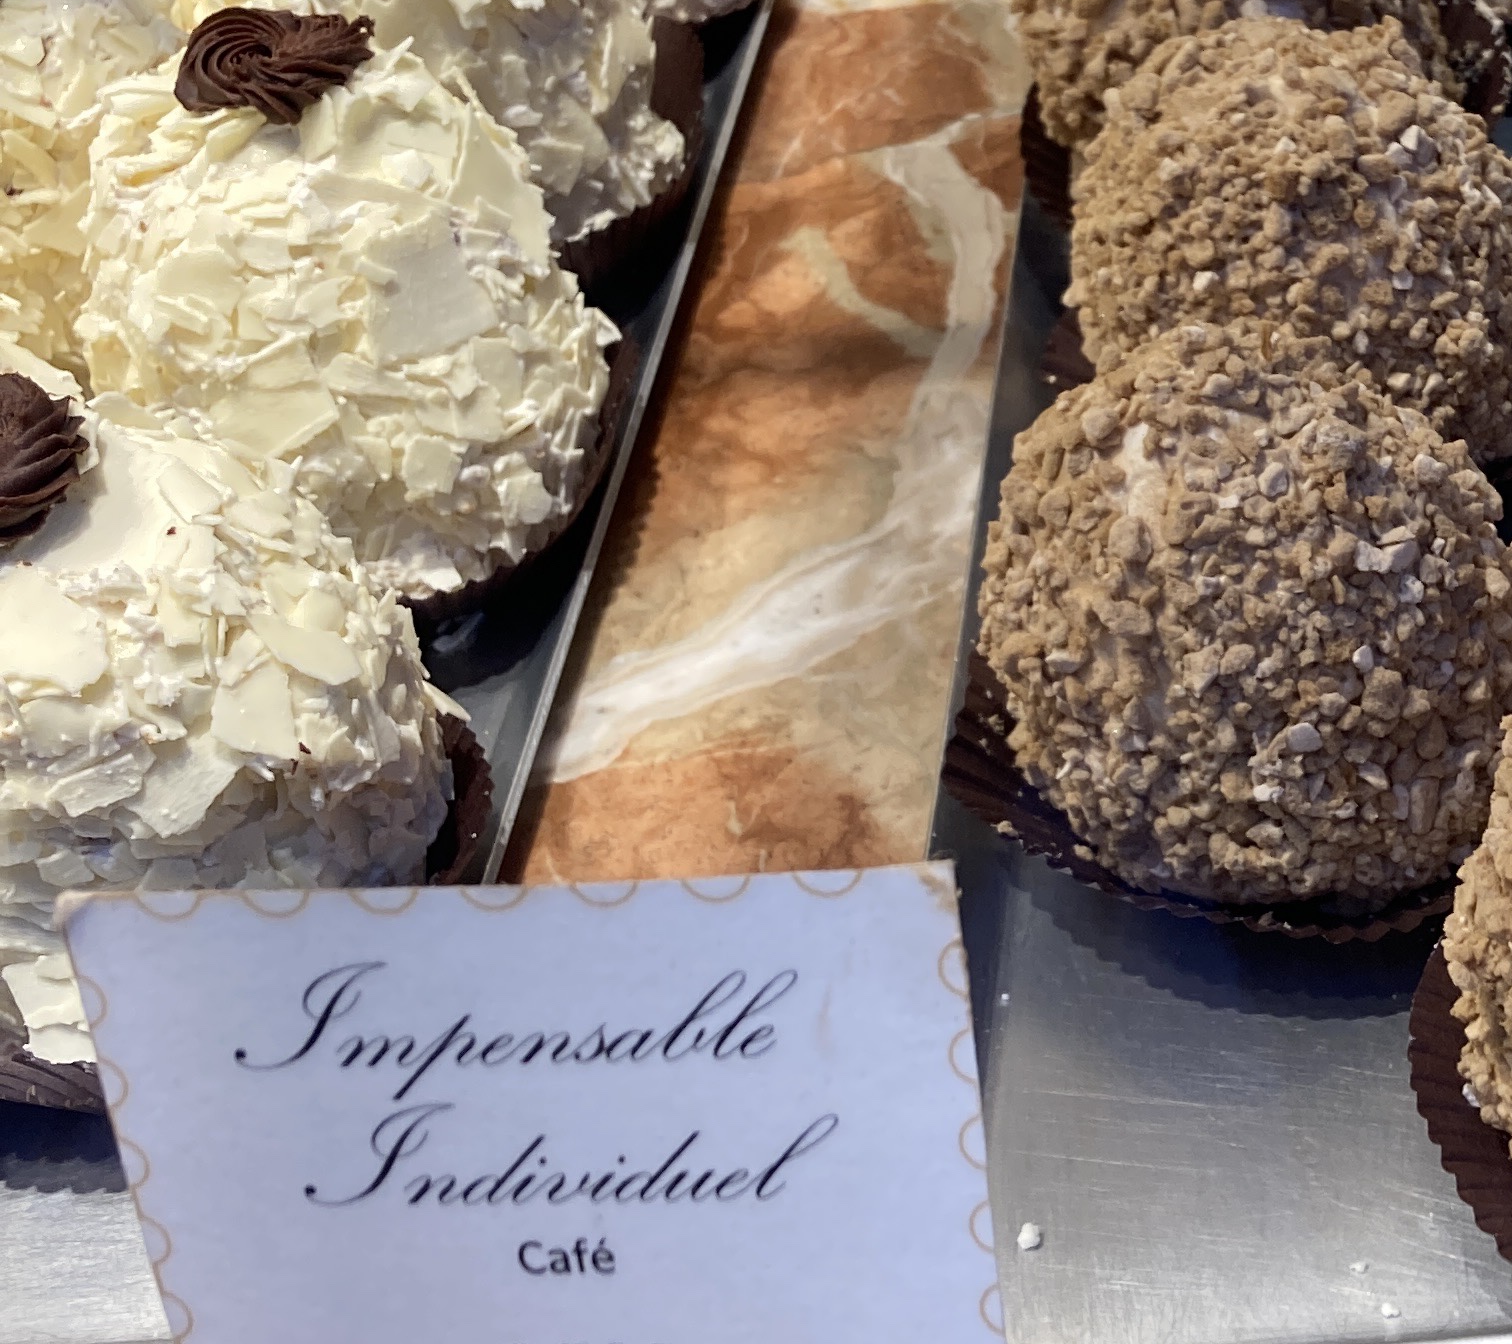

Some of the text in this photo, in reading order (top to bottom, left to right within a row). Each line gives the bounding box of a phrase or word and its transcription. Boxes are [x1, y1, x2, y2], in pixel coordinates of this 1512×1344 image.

[234, 960, 799, 1100] Impensable
[304, 1102, 840, 1208] Individuel
[516, 1235, 617, 1277] Café
